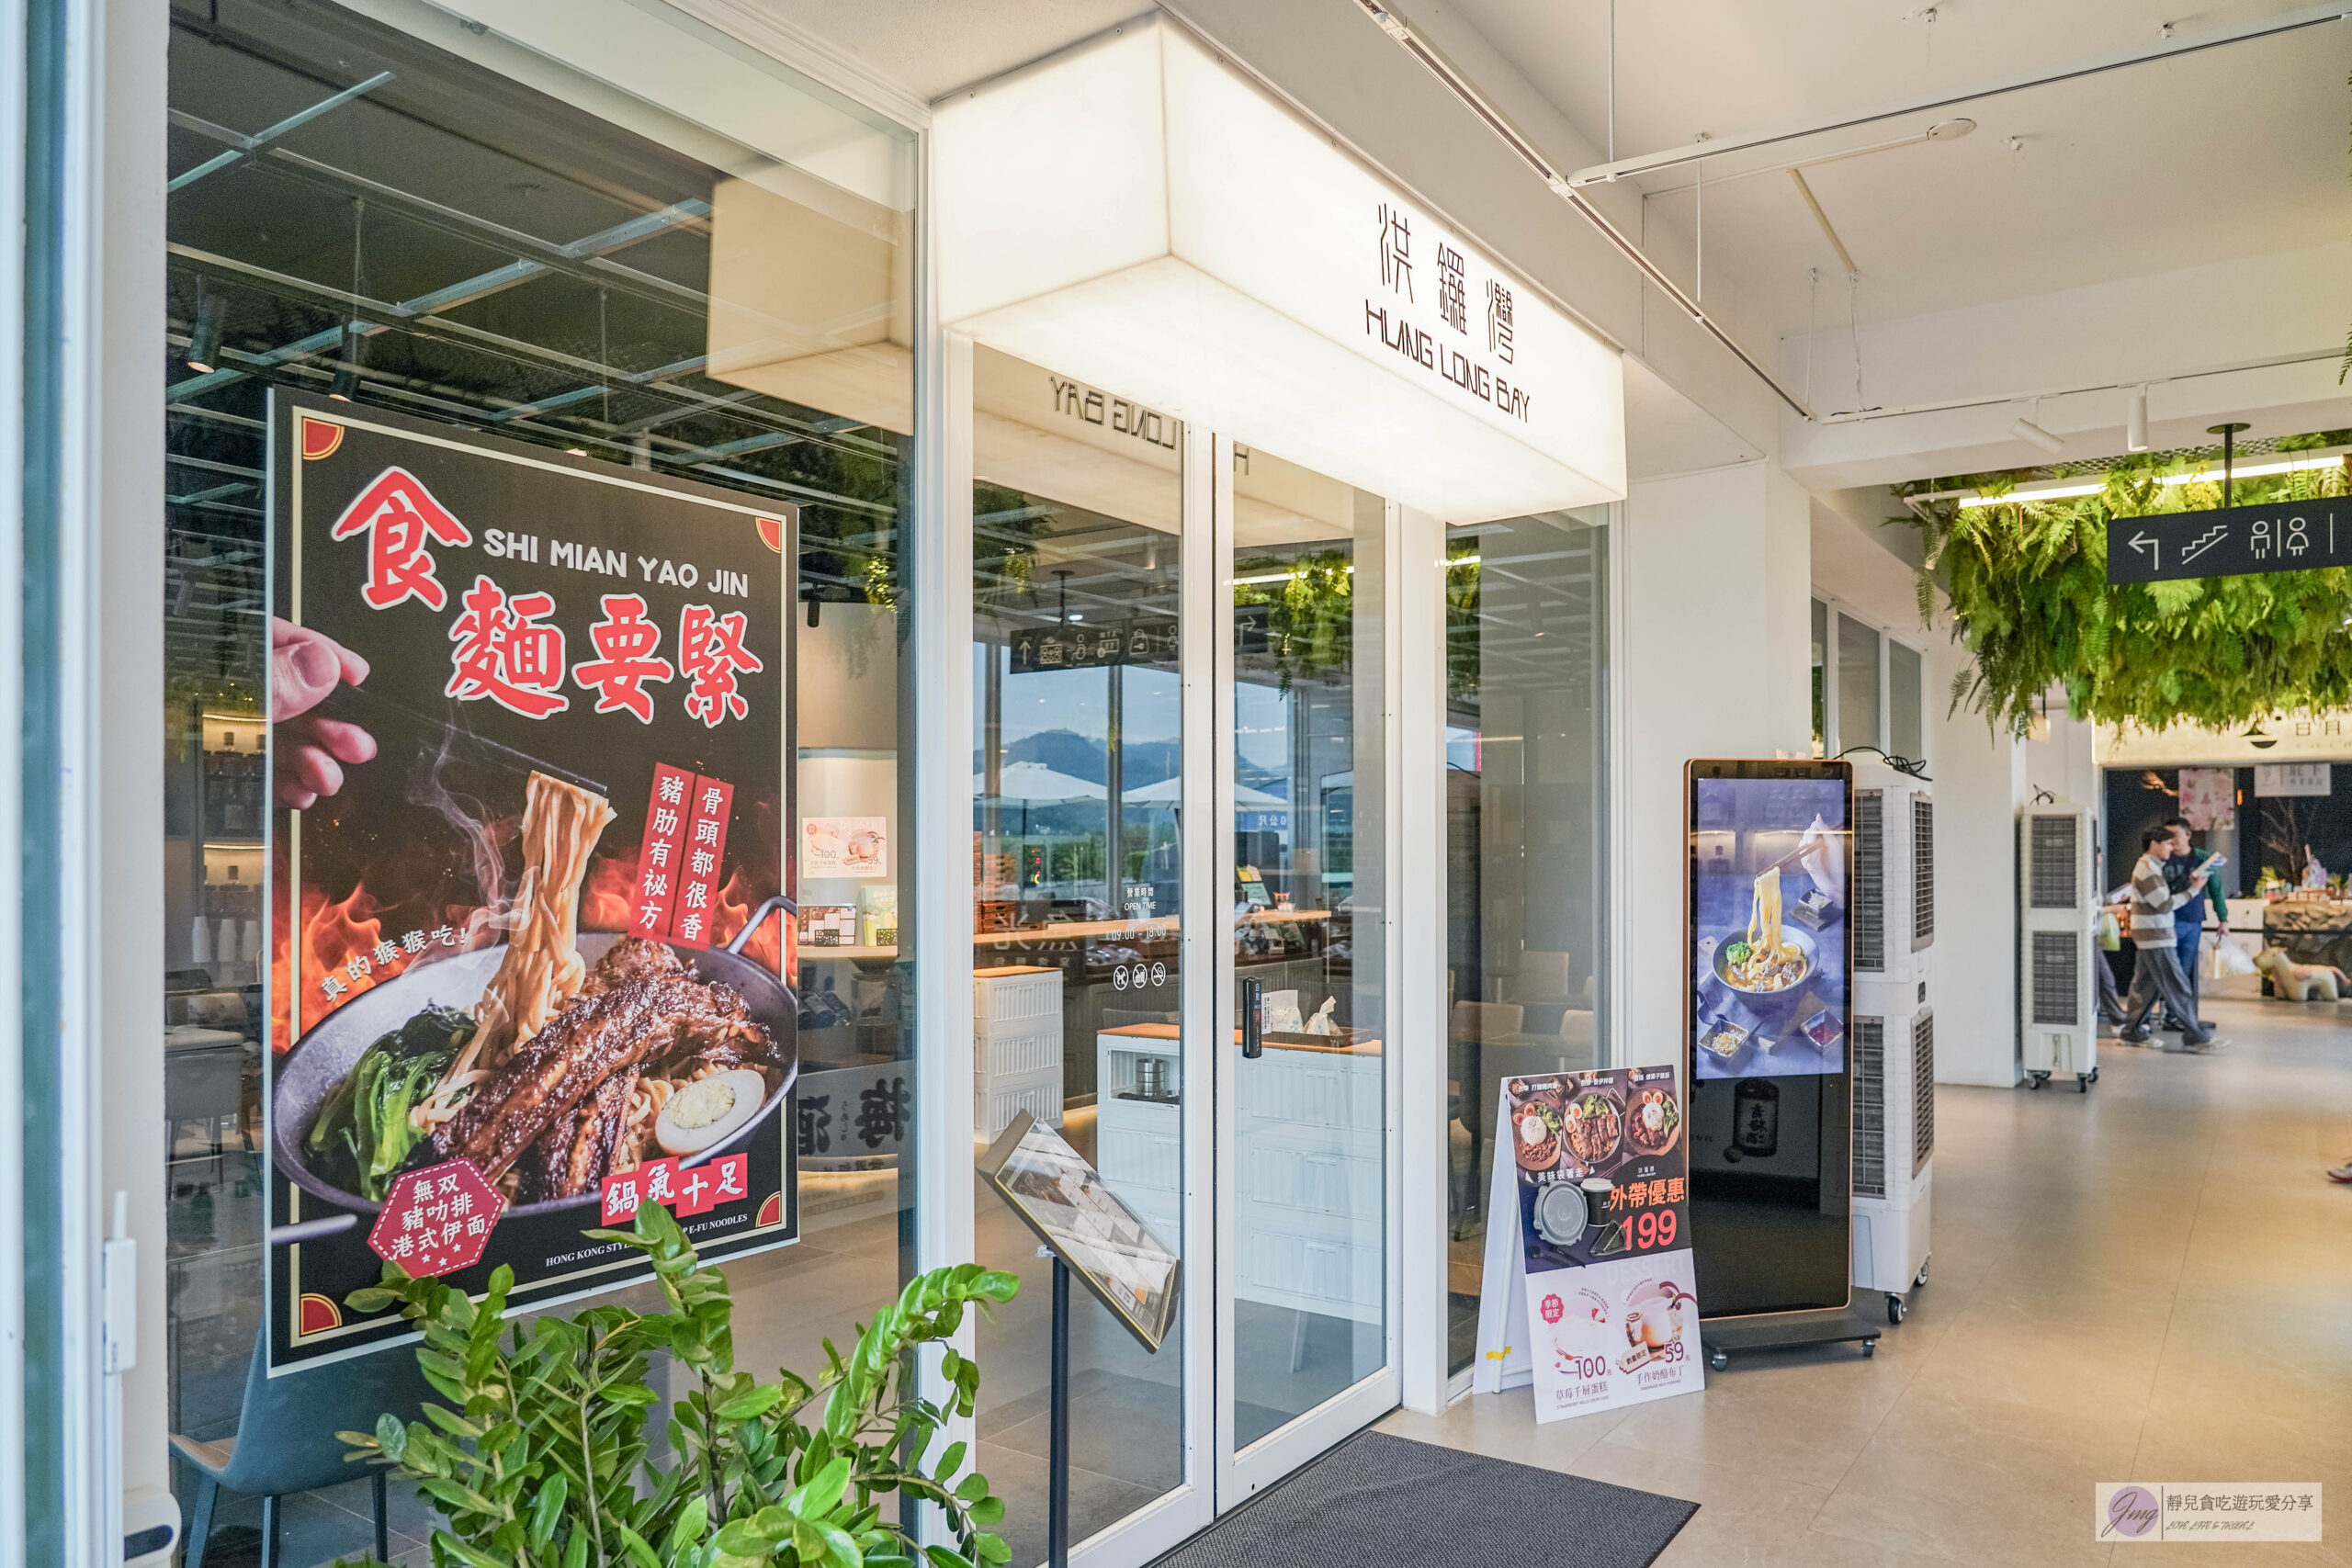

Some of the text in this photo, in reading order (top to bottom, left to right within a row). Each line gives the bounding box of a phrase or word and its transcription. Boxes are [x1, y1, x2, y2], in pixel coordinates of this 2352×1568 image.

[1440, 343, 1490, 402] LONG
[1496, 377, 1530, 423] BAY
[483, 527, 749, 598] SHI MIAN YAO JIN
[330, 465, 764, 728] 食麵要緊
[680, 787, 724, 942] 骨頭都很香
[1124, 901, 1156, 911] OPEN TIME
[1126, 886, 1154, 898] 營業時間
[1111, 929, 1135, 942] 09:00
[1146, 925, 1167, 938] 18:00
[413, 1173, 460, 1204] 無双
[605, 1160, 744, 1217] 鍋氣十足
[1609, 1177, 1685, 1212] 外帶優惠
[390, 1213, 486, 1259] 港式伊面
[546, 1250, 575, 1268] HONG
[576, 1244, 605, 1261] KONG
[605, 1236, 634, 1255] STYL
[689, 1223, 709, 1235] E-FU
[709, 1213, 748, 1231] NOODLES
[1622, 1209, 1678, 1252] 199
[1544, 1298, 1559, 1308] 季節
[1545, 1309, 1559, 1319] 限定
[1575, 1355, 1606, 1380] 100
[1665, 1341, 1684, 1363] 59
